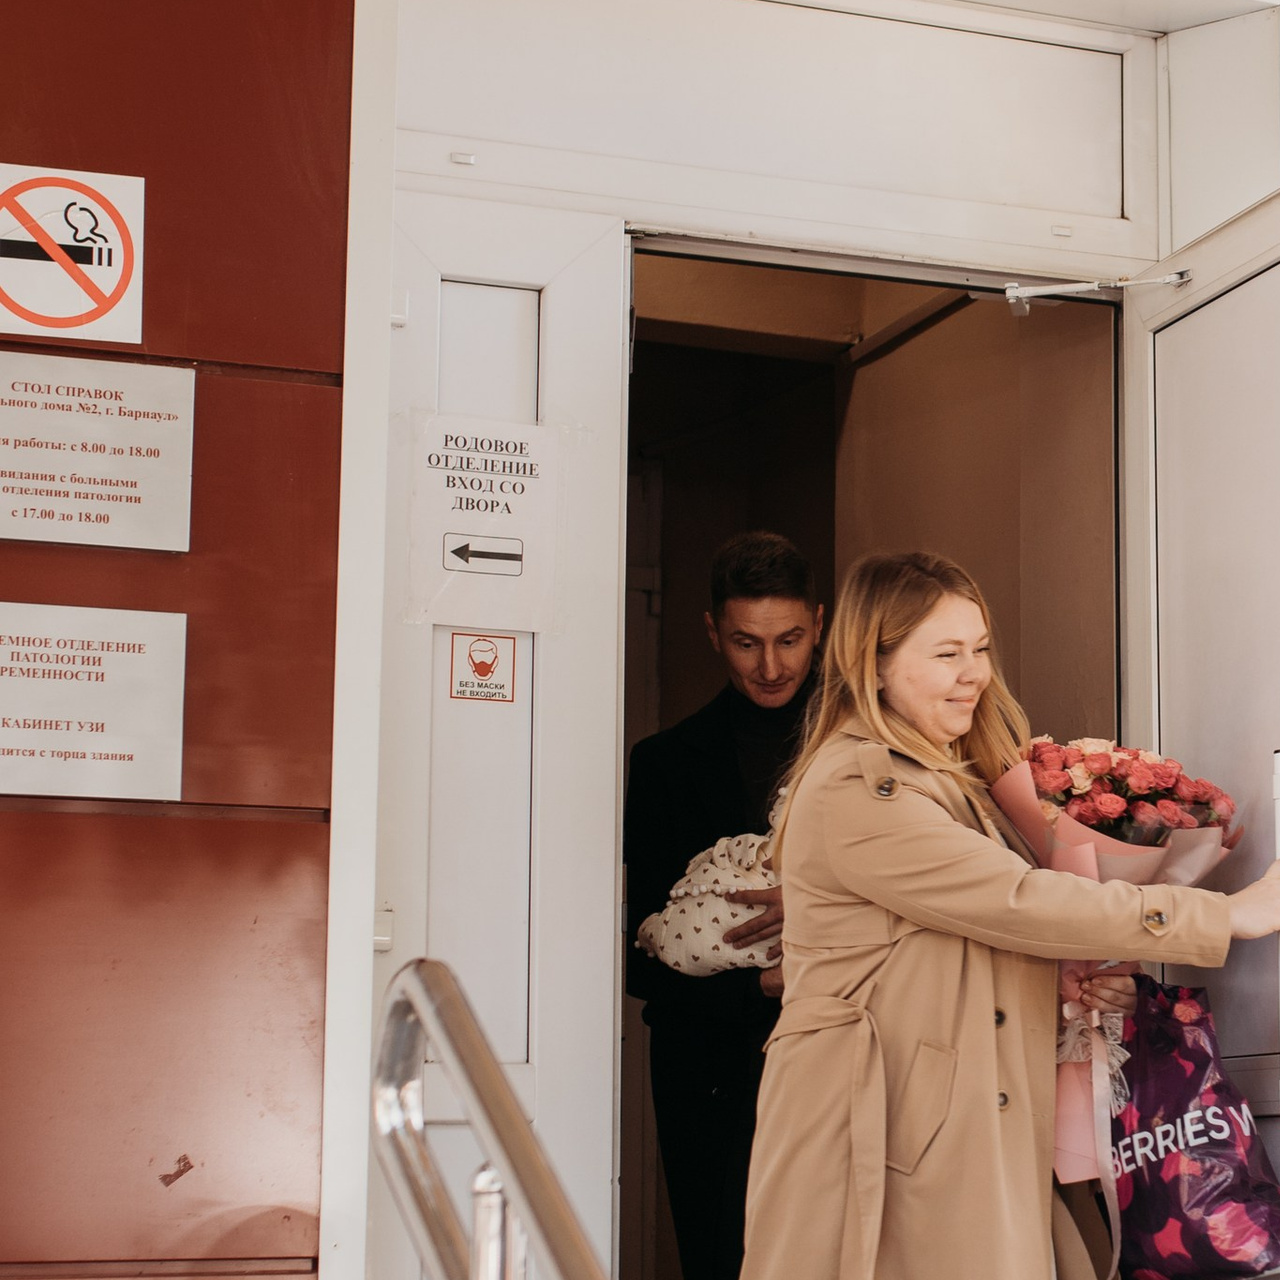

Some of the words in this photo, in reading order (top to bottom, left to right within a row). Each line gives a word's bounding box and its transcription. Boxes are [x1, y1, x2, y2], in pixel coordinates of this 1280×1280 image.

[11, 382, 51, 395] СТОЛ
[55, 385, 124, 401] СПРАВОК
[41, 402, 72, 412] дома
[76, 403, 102, 416] №2,
[106, 407, 113, 416] г.
[118, 406, 179, 422] Барнаул»
[13, 438, 66, 451] работы:
[80, 442, 106, 454] 8.00
[109, 446, 124, 456] до
[129, 447, 160, 458] 18.00
[443, 434, 529, 457] РОДОВОЕ
[427, 453, 539, 478] ОТДЕЛЕНИЕ
[70, 474, 138, 488] больными
[446, 475, 495, 494] ВХОД
[500, 481, 525, 495] СО
[2, 486, 70, 499] отделения
[74, 491, 142, 504] патологии
[452, 496, 512, 514] ДВОРА
[11, 509, 18, 517] с
[23, 508, 55, 520] 17.00
[58, 512, 73, 522] до
[78, 512, 109, 524] 18.00
[56, 638, 146, 654] ОТДЕЛЕНИЕ
[10, 652, 102, 667] ПАТОЛОГИИ
[0, 667, 105, 682] РЕМЕННОСТИ
[477, 682, 505, 690] МАСКИ
[470, 690, 507, 699] ВХОДИТЬ
[2, 718, 73, 732] КАБИНЕТ
[78, 722, 105, 733] УЗИ
[50, 750, 86, 761] торца
[90, 751, 134, 762] здания
